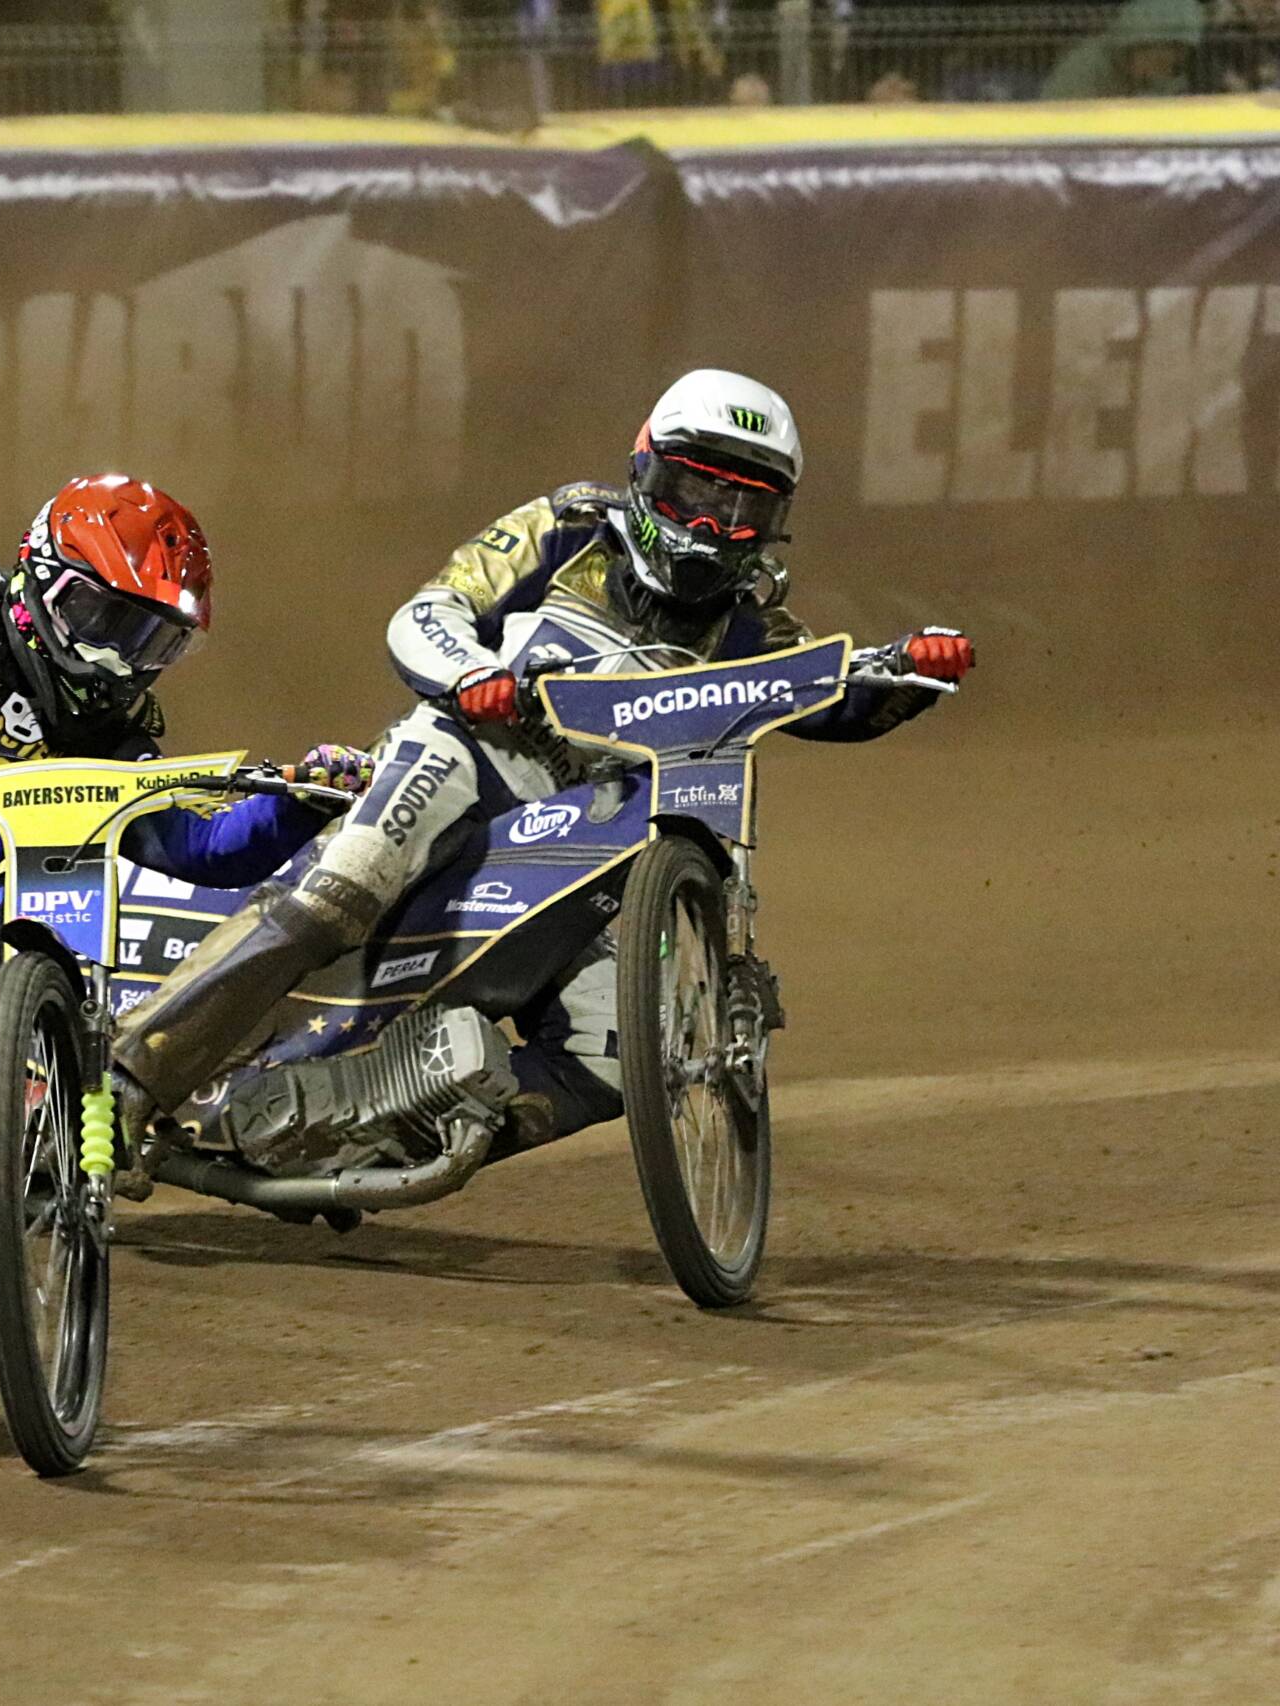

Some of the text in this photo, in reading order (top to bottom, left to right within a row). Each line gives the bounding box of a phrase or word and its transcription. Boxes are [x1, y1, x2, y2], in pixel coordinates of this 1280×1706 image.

[862, 284, 1280, 502] ELEK
[613, 680, 794, 728] BOGDANKA
[2, 785, 120, 809] BAYERSYSTEM
[382, 753, 459, 847] SOUDAL
